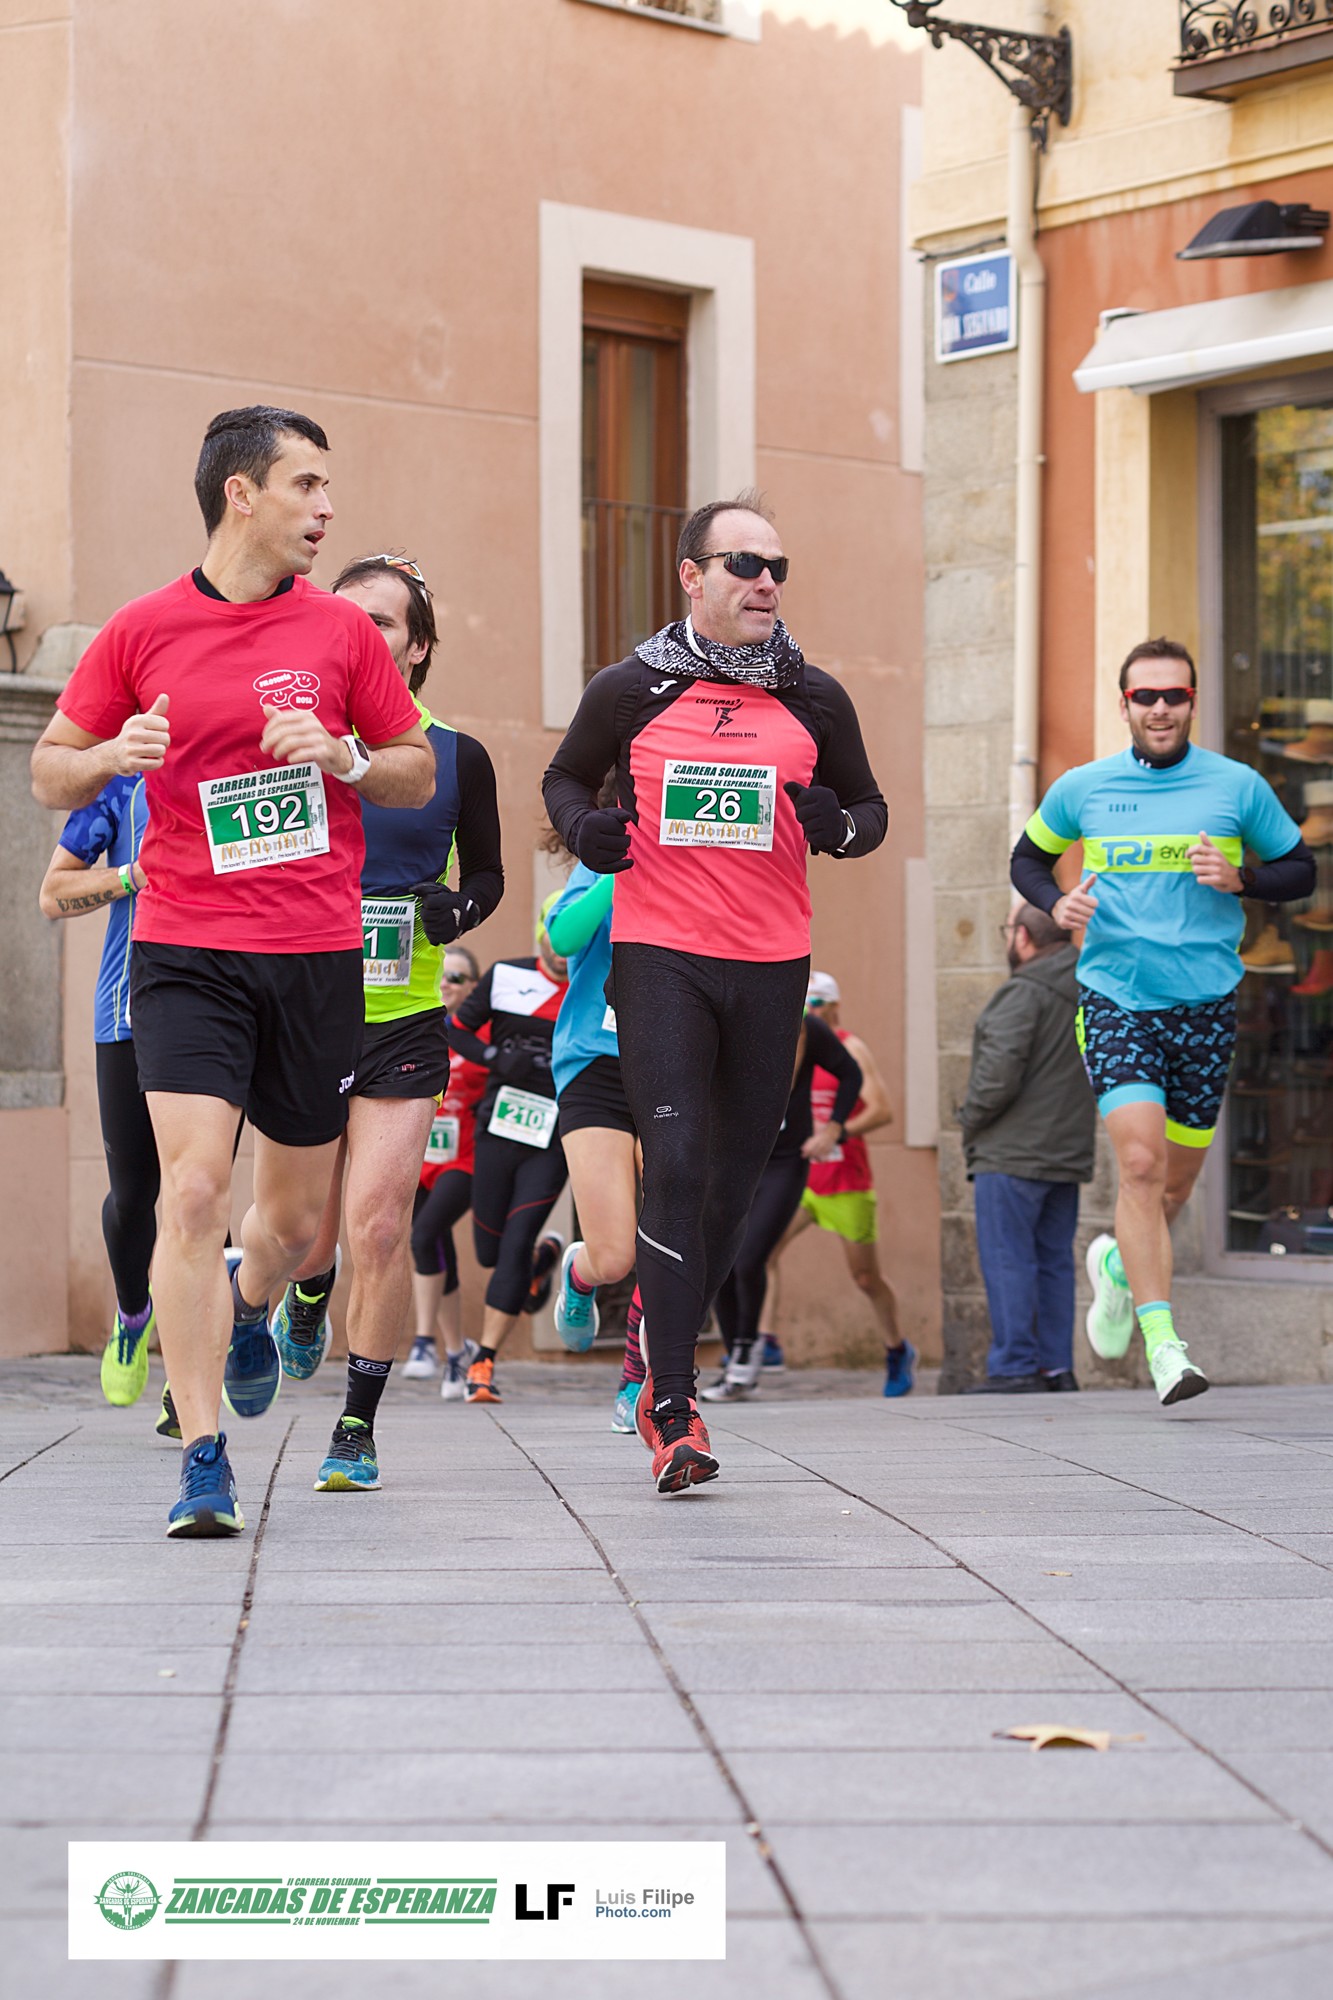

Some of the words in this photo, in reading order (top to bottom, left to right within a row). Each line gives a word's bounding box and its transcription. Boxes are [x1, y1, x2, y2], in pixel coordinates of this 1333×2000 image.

[210, 776, 257, 795] CARRERA
[260, 765, 312, 785] SOLIDARIA
[673, 764, 717, 776] CARRERA
[718, 767, 768, 779] SOLIDARIA
[713, 779, 723, 787] DE
[257, 788, 266, 797] DE
[694, 788, 742, 823] 26
[230, 793, 306, 838] 192
[362, 904, 408, 916] SOLIDARIA
[363, 927, 379, 959] 1
[503, 1103, 542, 1130] 210
